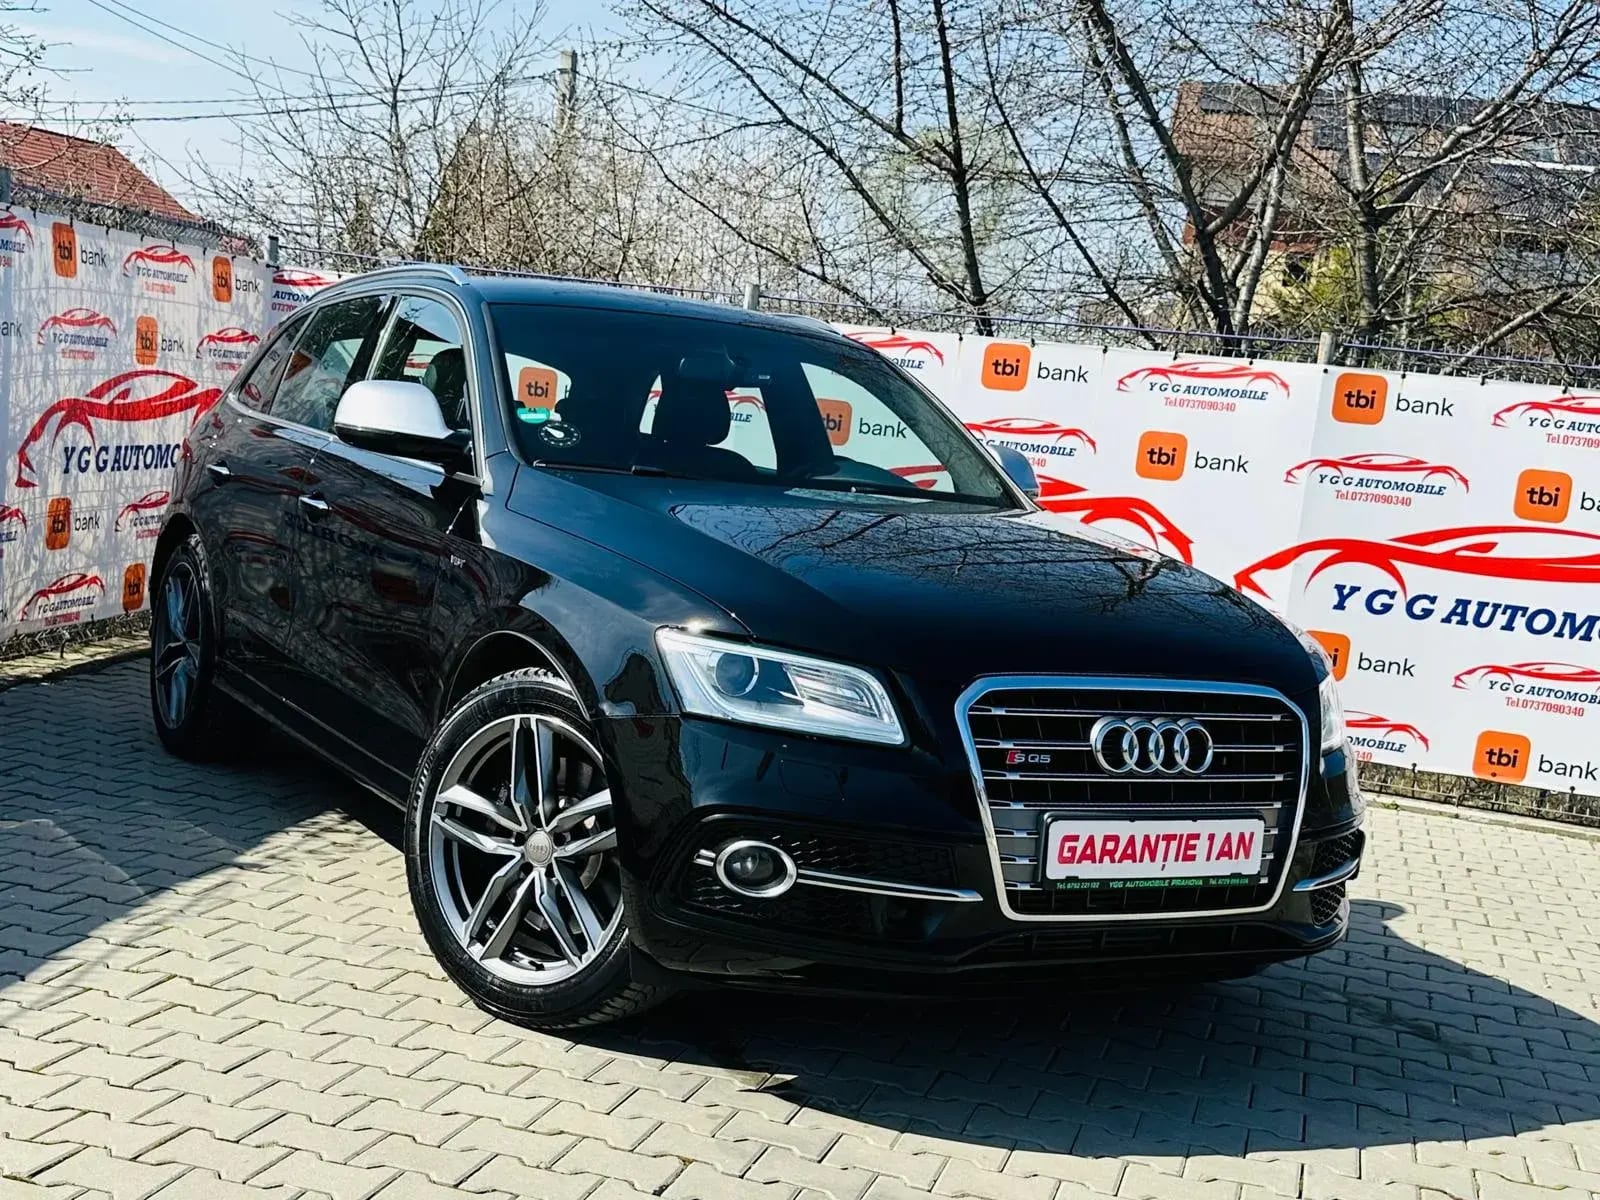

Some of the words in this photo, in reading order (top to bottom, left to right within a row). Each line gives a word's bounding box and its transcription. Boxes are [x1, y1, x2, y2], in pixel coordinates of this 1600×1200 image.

[57, 240, 73, 261] tbi
[80, 244, 107, 267] bank
[217, 272, 228, 288] tbi
[235, 274, 260, 293] bank
[0, 318, 22, 337] ank
[140, 331, 154, 350] tbi
[161, 335, 184, 352] bank
[992, 358, 1021, 377] tbi
[1037, 361, 1089, 383] bank
[526, 381, 550, 398] tbi
[1183, 385, 1269, 401] AUTOMOBILE
[1344, 390, 1377, 410] tbi
[1396, 392, 1454, 417] bank
[822, 412, 843, 432] bi
[859, 417, 907, 439] bank
[1147, 446, 1177, 466] tbi
[1194, 451, 1249, 474] bank
[1354, 477, 1447, 496] AUTOMOBILE
[1526, 486, 1560, 507] tbi
[51, 513, 66, 533] tbi
[74, 511, 100, 532] bank
[127, 578, 141, 596] tbi
[1440, 598, 1600, 643] AUTOM
[1357, 651, 1416, 677] bank
[1485, 747, 1519, 768] tbi
[1538, 754, 1598, 781] bank
[1057, 832, 1201, 871] GARANȚIE
[1205, 832, 1215, 862] 1
[1215, 831, 1255, 861] AN
